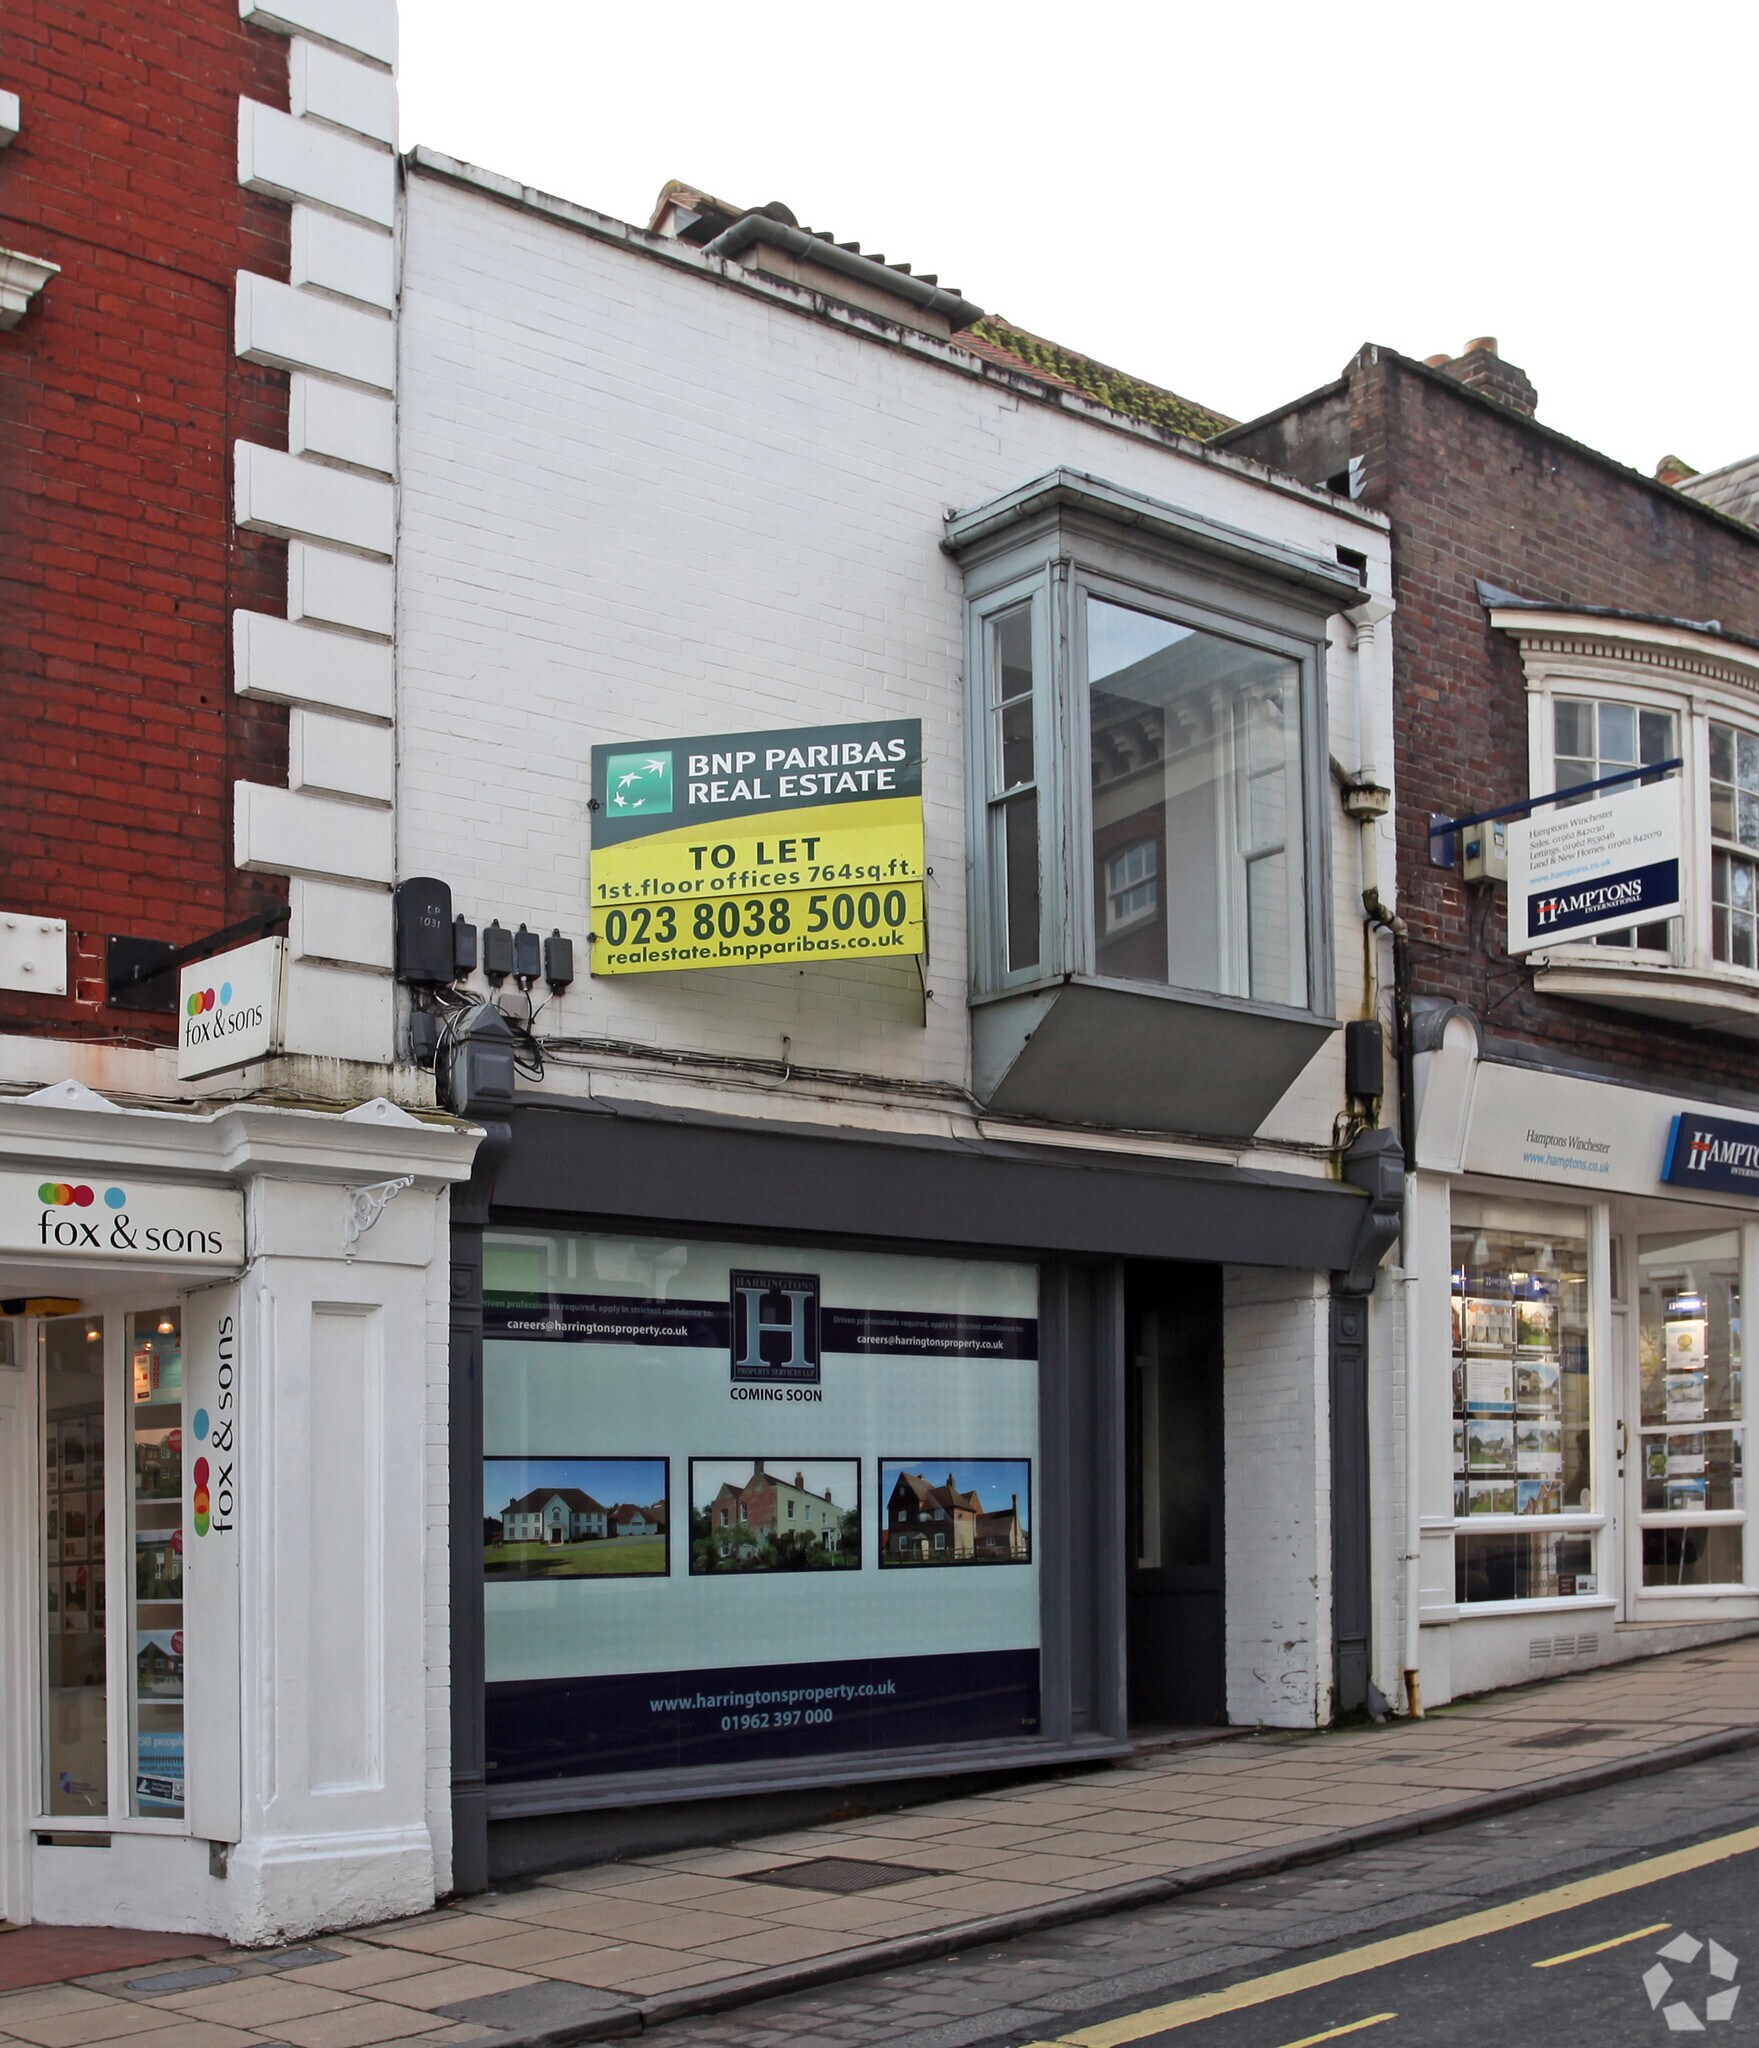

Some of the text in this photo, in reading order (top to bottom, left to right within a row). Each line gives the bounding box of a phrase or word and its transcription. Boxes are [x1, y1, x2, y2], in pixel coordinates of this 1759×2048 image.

[688, 738, 907, 777] BNP PARIBAS
[688, 767, 896, 804] REAL ESTATE
[1529, 809, 1614, 839] Hamptons Winchester
[1552, 832, 1575, 844] 01962
[1562, 839, 1586, 851] 01962
[688, 837, 821, 871] TO LET
[1530, 857, 1549, 870] Land
[1549, 857, 1557, 866] &
[1557, 852, 1576, 863] New
[597, 877, 705, 900] 1st.floor
[711, 870, 801, 891] offices
[1529, 859, 1612, 885] www.hamptons.co.uk
[1536, 878, 1642, 926] HAMPTONS
[1584, 894, 1642, 914] INTERNATIONAL
[605, 889, 907, 946] 023 8038 5000
[606, 930, 905, 965] realestate.bnpparibas.co.uk
[185, 1004, 263, 1047] fox & sons
[1526, 1128, 1612, 1154] Hamptons Winchester
[1522, 1151, 1611, 1174] www.hamptons.co.uk
[37, 1209, 223, 1255] fox & sons
[735, 1277, 815, 1290] HARRINGTONS
[506, 1300, 561, 1311] professionals
[507, 1320, 688, 1338] careers@harringtonsproperty.co.uk
[736, 1287, 815, 1368] H
[857, 1334, 1004, 1351] careers@harringtonsproperty.co.uk
[737, 1367, 770, 1376] PROPERTY
[730, 1387, 823, 1402] COMING SOON
[212, 1316, 234, 1536] fox & sons
[650, 1679, 897, 1712] www.harringtonsproperty.co.uk
[721, 1708, 833, 1731] 01962 397 000
